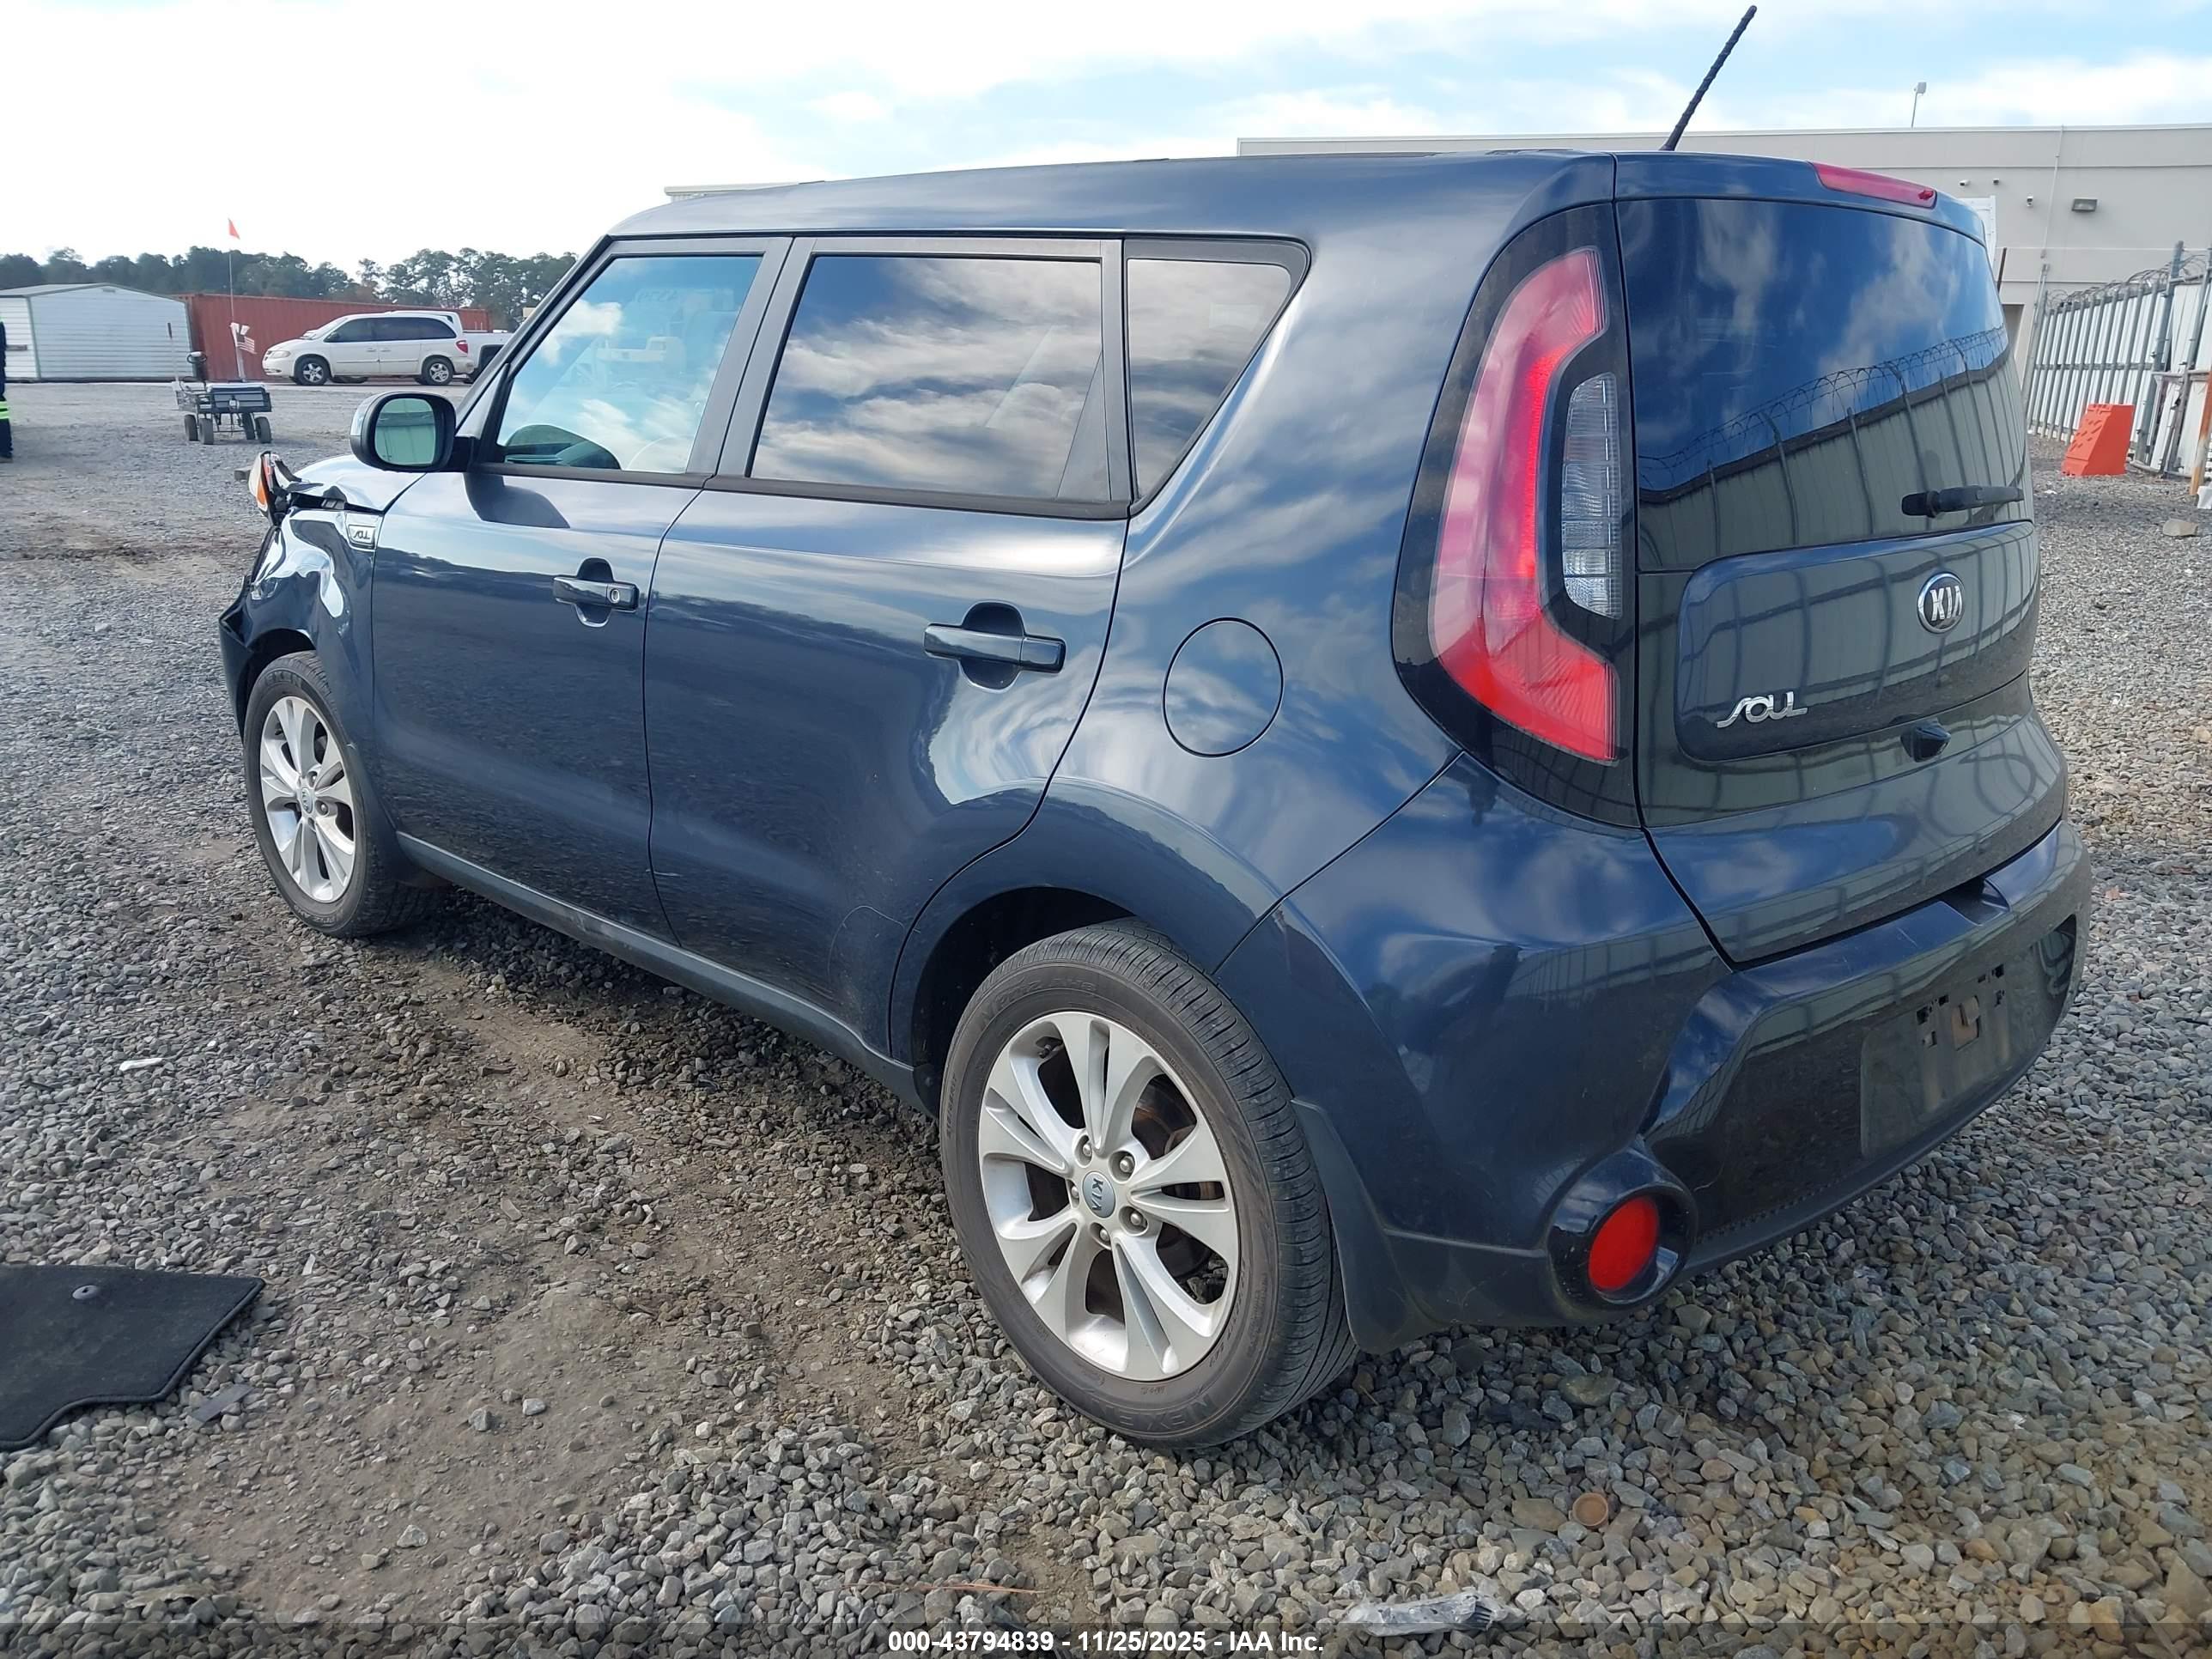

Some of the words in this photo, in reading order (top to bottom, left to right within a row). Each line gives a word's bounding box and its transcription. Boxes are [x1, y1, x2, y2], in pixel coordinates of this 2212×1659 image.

[1929, 585, 1963, 622] KIA
[1716, 690, 1808, 728] SOUL
[1091, 1177, 1104, 1211] KIA
